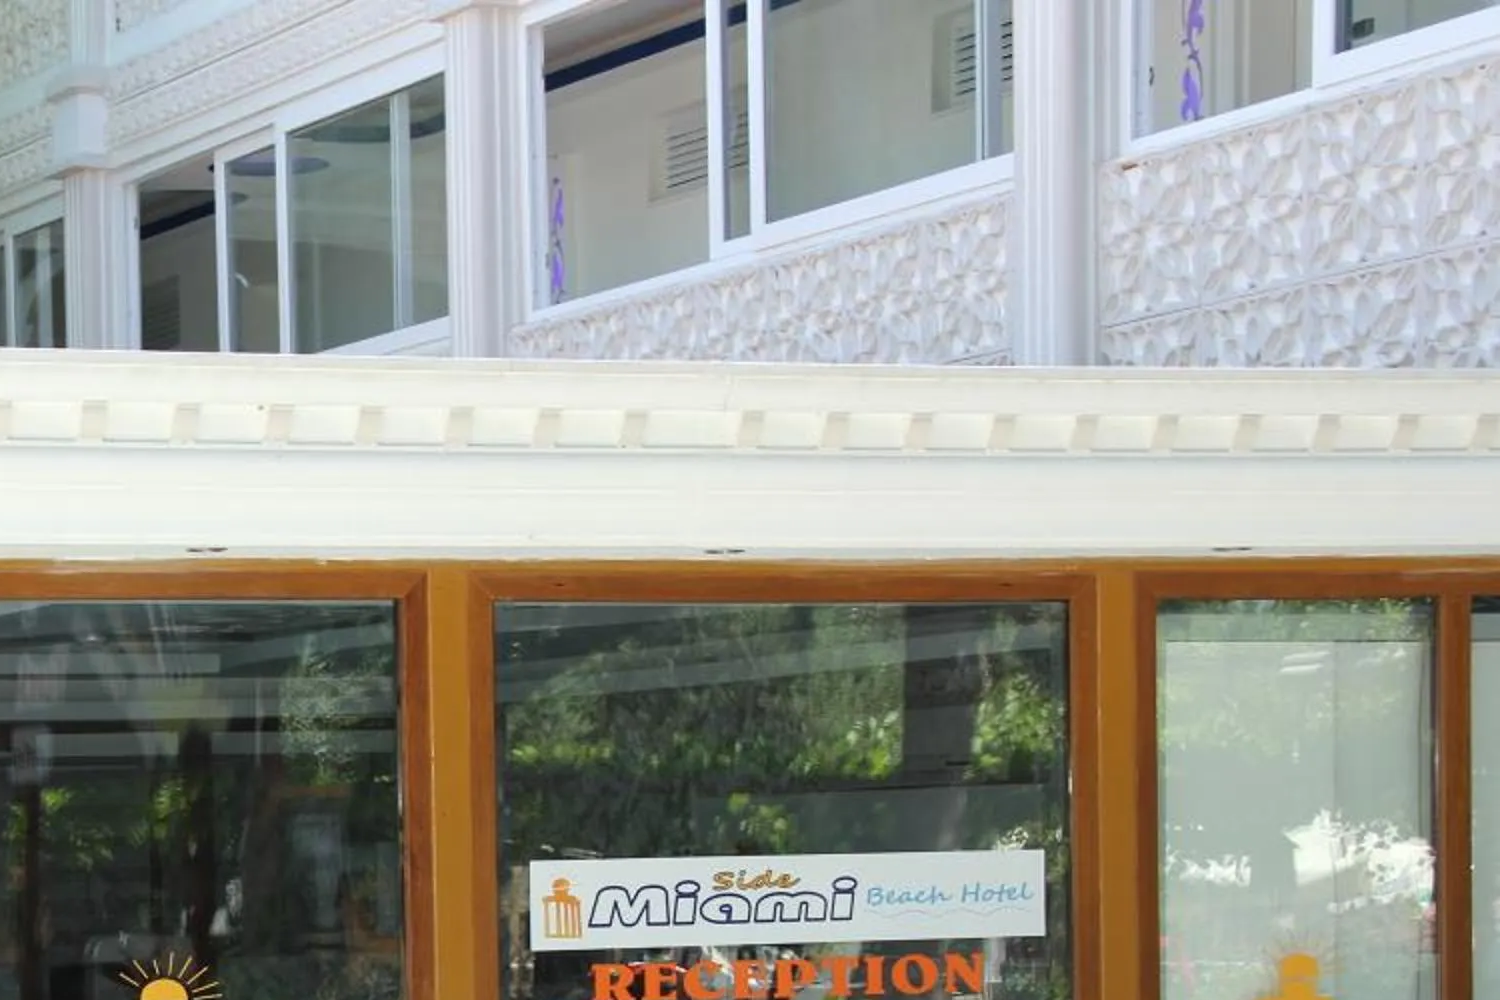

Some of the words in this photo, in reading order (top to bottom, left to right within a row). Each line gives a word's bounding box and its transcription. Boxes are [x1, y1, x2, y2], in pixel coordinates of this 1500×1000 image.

[711, 868, 801, 892] Side
[588, 875, 858, 928] Miami
[866, 884, 953, 909] Beach
[961, 881, 1035, 903] Hotel
